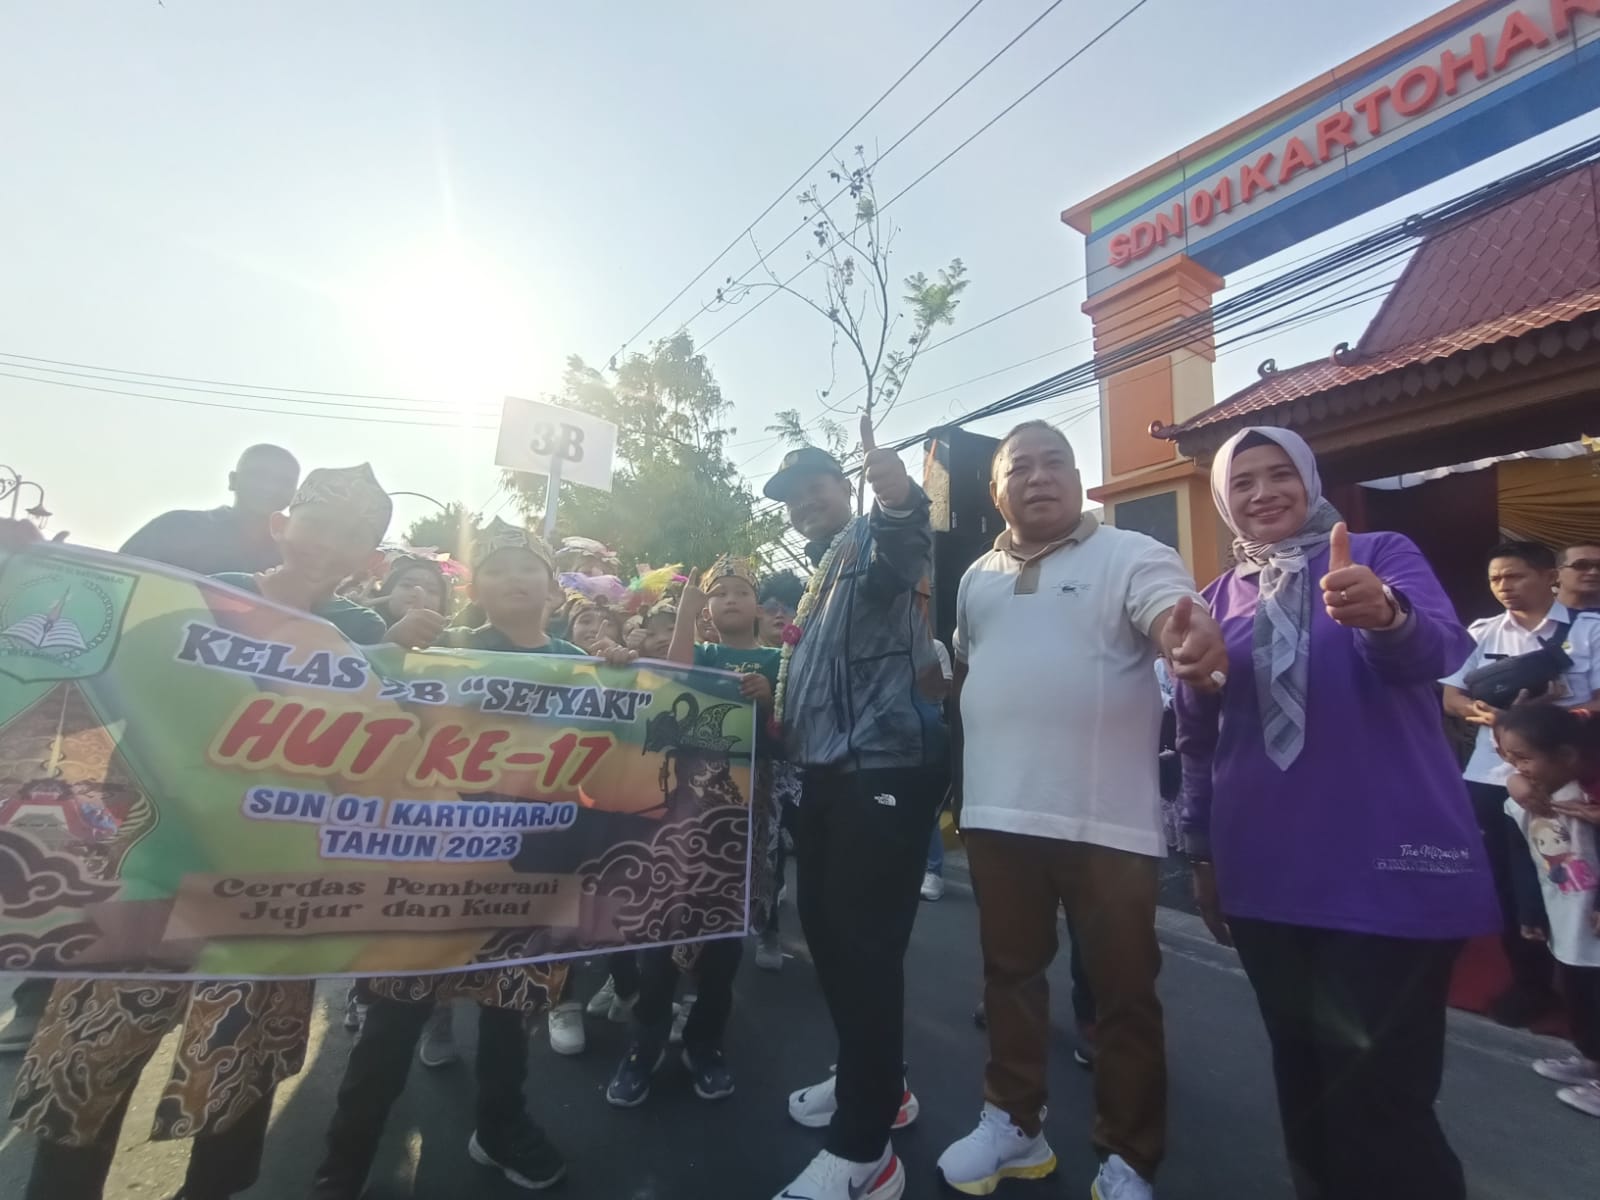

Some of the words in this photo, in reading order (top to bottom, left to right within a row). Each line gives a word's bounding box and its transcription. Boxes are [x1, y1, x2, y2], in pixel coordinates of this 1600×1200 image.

[1109, 202, 1185, 269] SDN
[1190, 176, 1233, 227] 01
[529, 421, 585, 463] 3B
[176, 622, 370, 690] KELAS
[217, 698, 414, 775] HUT
[414, 724, 615, 789] KE-17
[248, 788, 326, 820] SDN
[336, 799, 378, 824] 01
[391, 802, 576, 829] KARTOHARJO
[324, 829, 437, 858] TAHUN
[443, 834, 521, 859] 2023
[213, 878, 366, 898] Cerdas
[384, 876, 559, 897] Pemberani
[239, 900, 364, 929] Jujur
[381, 899, 451, 918] dan
[460, 898, 531, 917] Kuat
